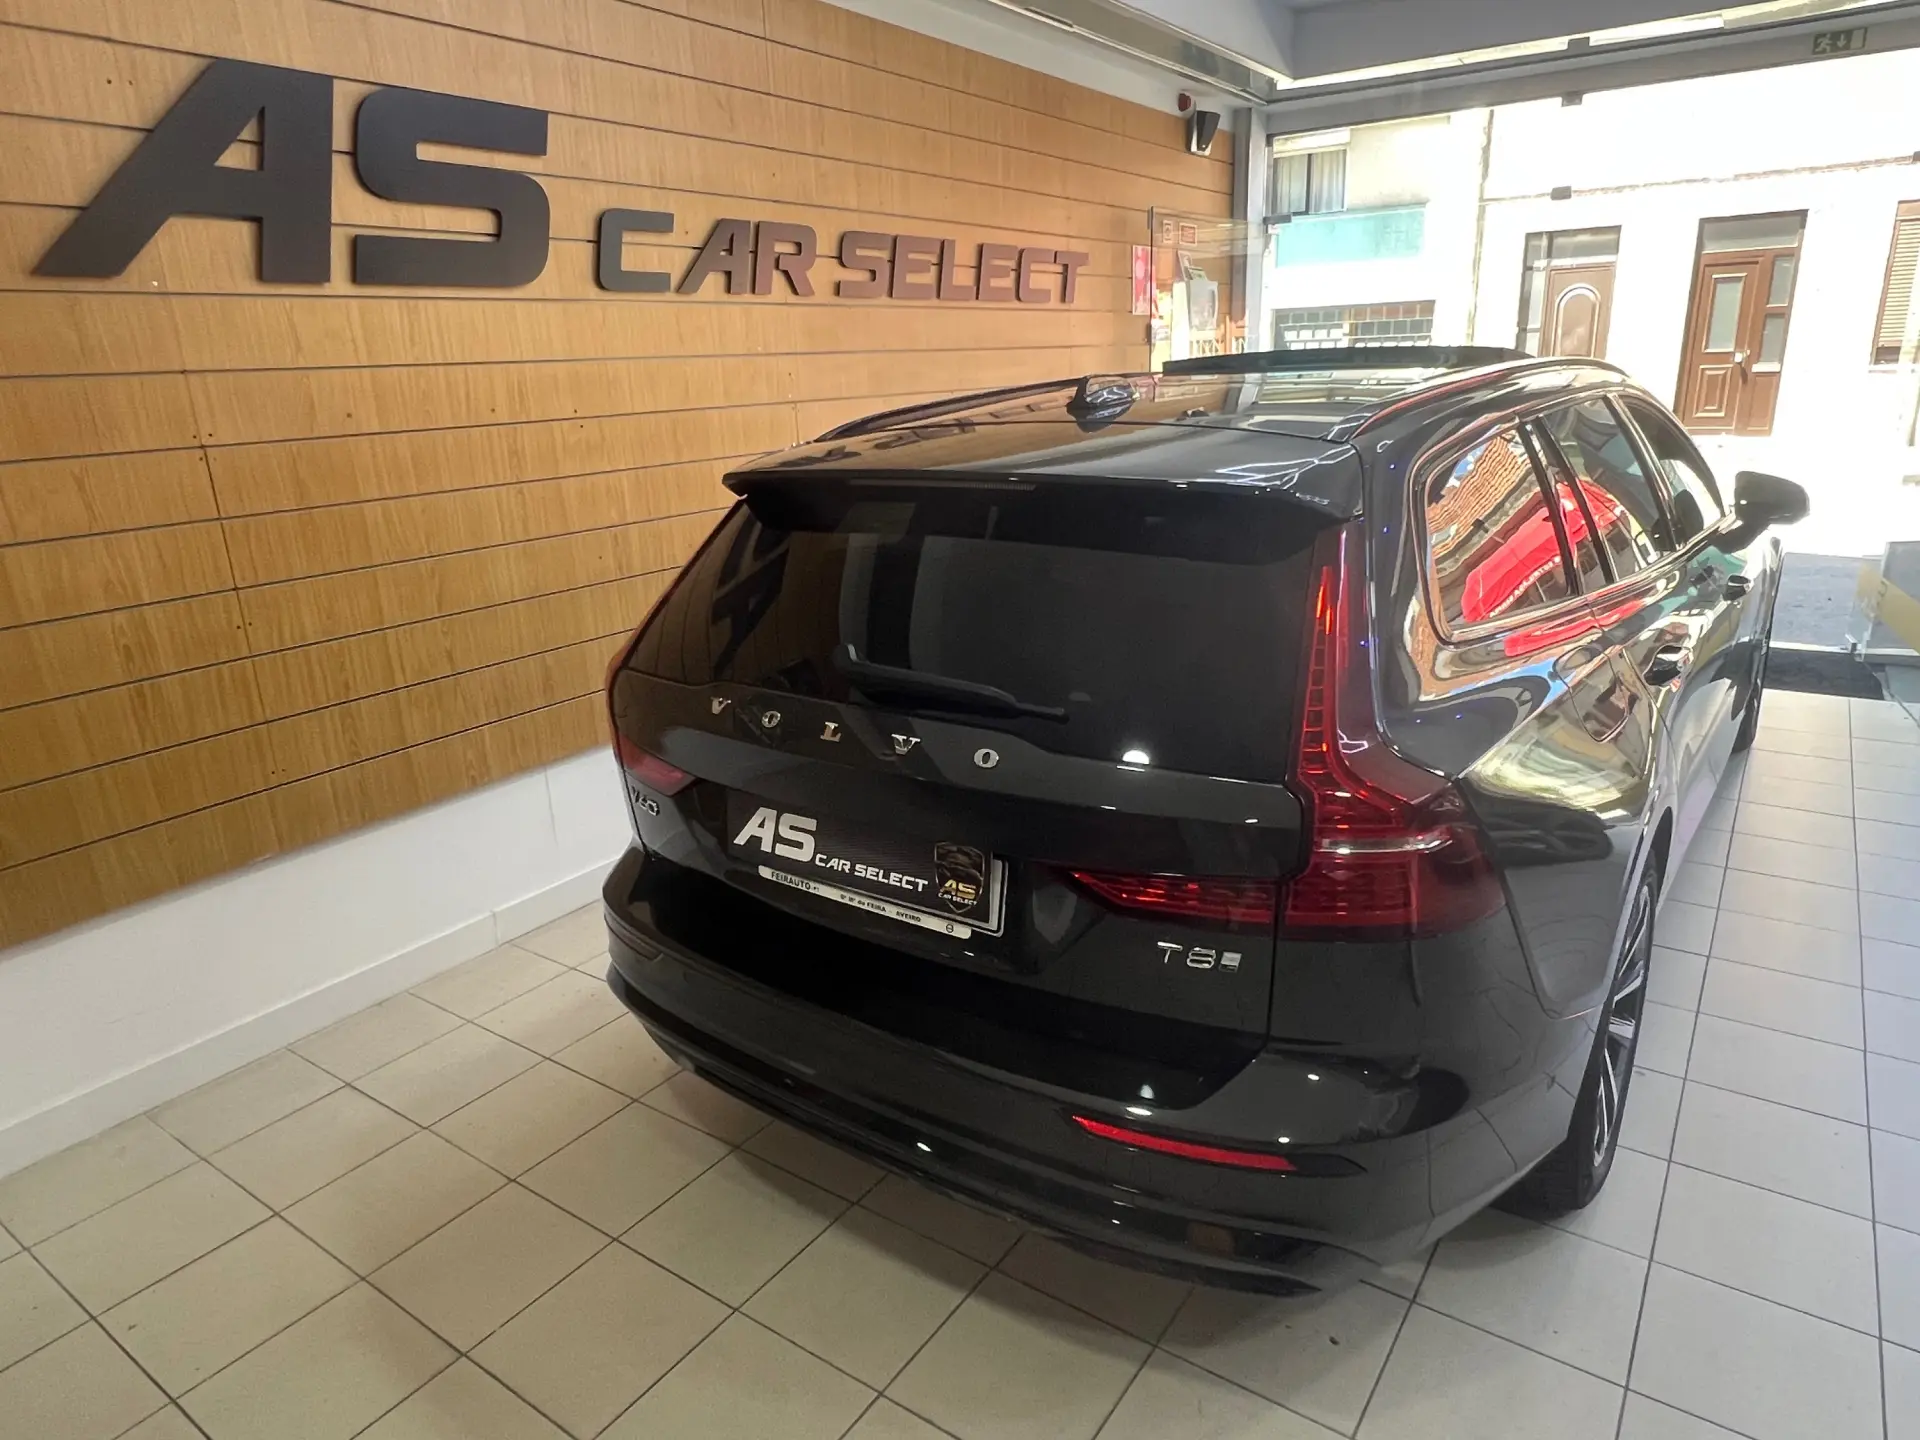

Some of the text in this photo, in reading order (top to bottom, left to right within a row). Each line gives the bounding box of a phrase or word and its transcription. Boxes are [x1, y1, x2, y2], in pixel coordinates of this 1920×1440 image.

[31, 58, 1089, 304] AS CAR SELECT
[710, 697, 1000, 769] VOLVO
[630, 785, 660, 817] V60
[734, 806, 929, 892] AS CAR SELECT
[940, 879, 977, 900] AS
[1157, 941, 1216, 969] T8
